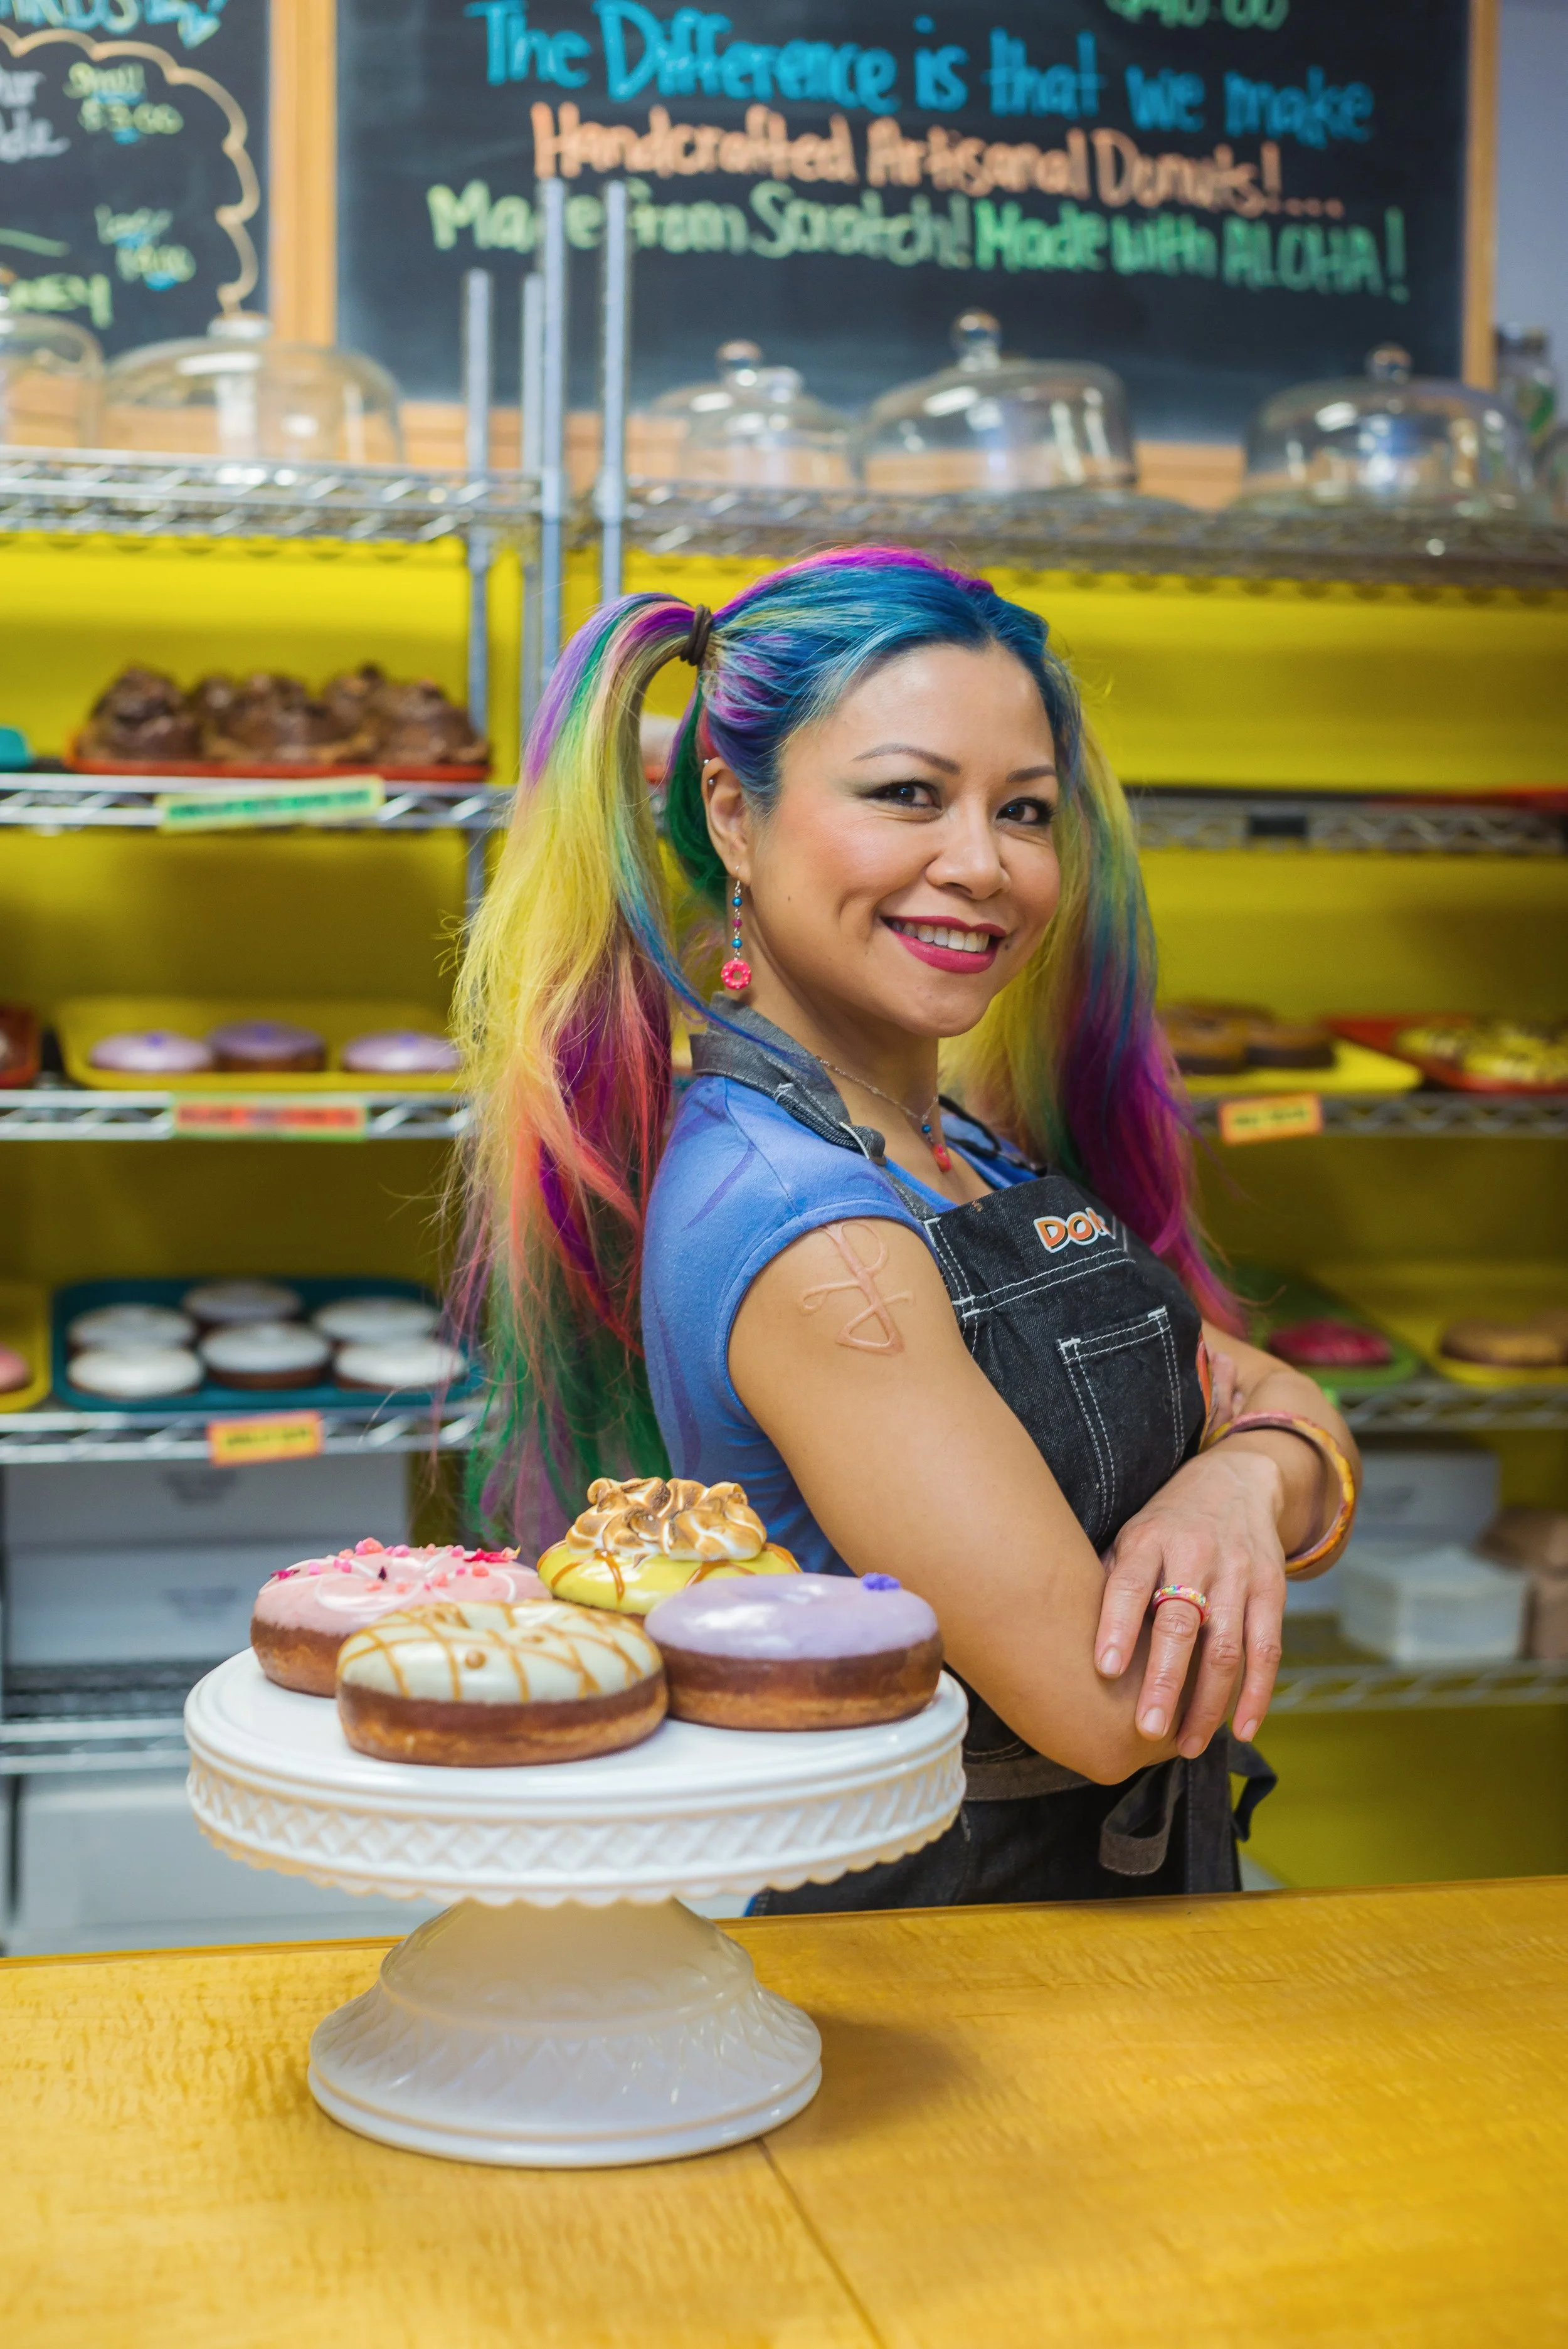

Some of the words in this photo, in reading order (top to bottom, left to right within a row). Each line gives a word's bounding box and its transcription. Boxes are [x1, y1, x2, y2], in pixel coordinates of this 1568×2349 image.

[464, 0, 591, 87] The
[592, 0, 902, 114] Difference
[913, 15, 970, 112] is
[982, 28, 1104, 118] that
[1126, 65, 1205, 132] we
[1223, 66, 1375, 148] make
[530, 101, 859, 184] Handcrafted
[867, 117, 1090, 199] Artisanal
[426, 179, 606, 252] Mae
[974, 199, 1107, 274] Made
[1110, 213, 1218, 277] with
[1223, 206, 1410, 304] ALOHA!
